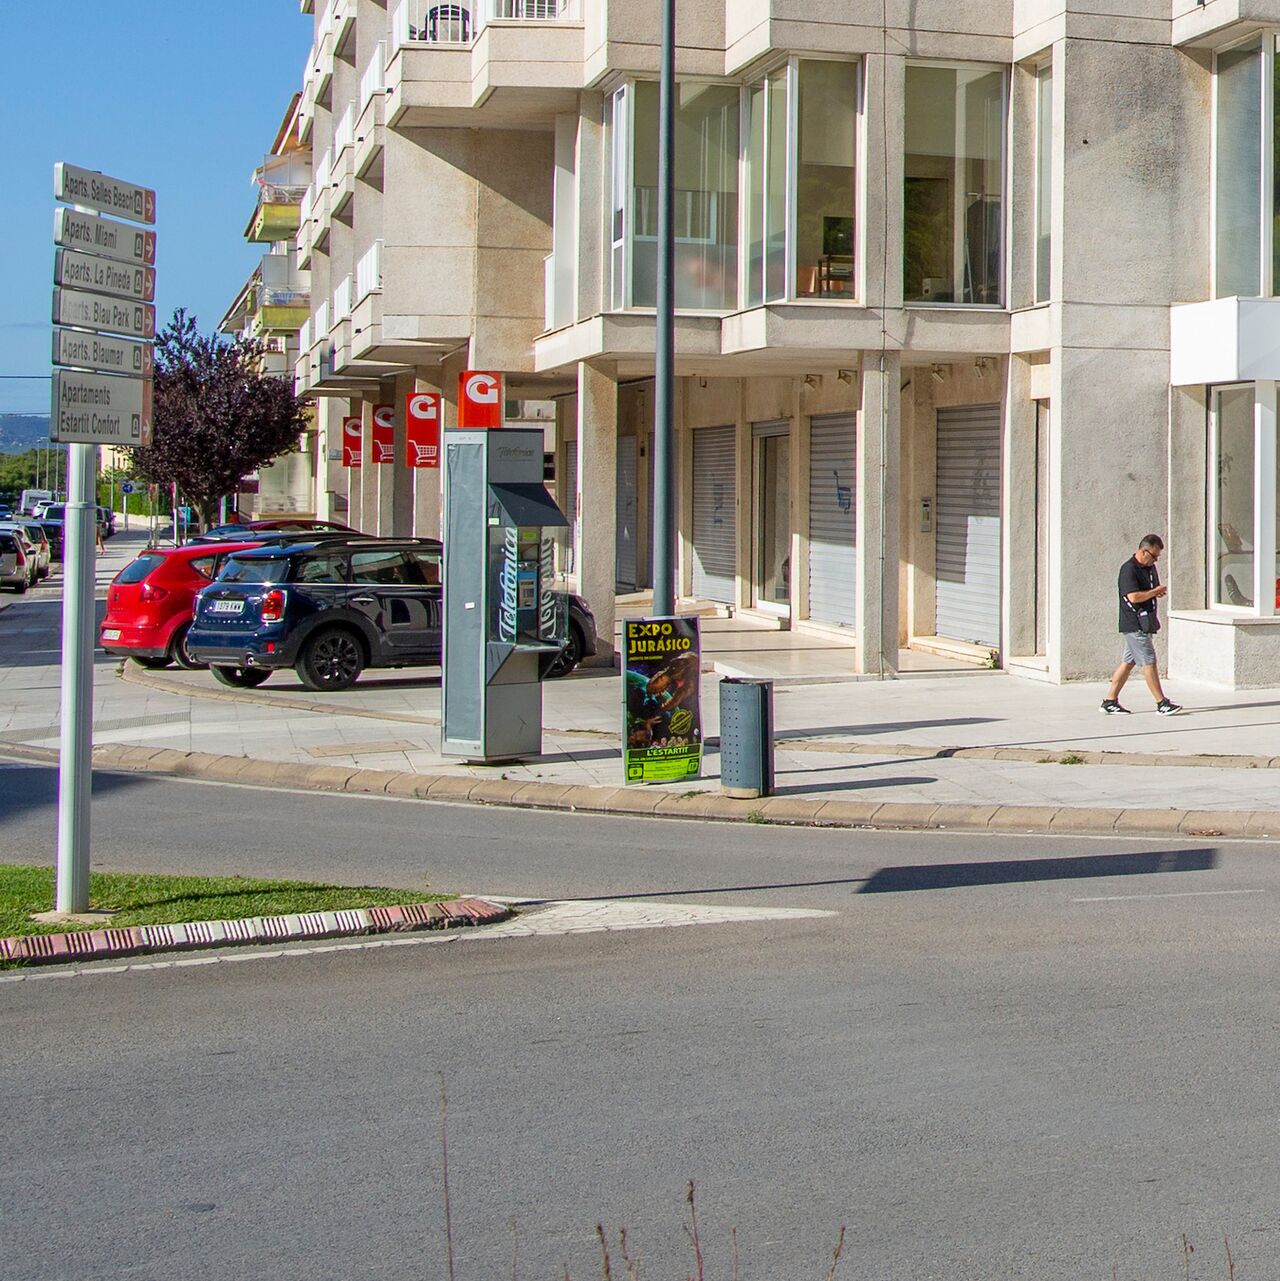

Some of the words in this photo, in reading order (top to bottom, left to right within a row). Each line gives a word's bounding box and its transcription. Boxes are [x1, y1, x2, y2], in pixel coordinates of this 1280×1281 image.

[64, 171, 90, 199] Aparts.
[113, 186, 133, 211] Beach
[64, 215, 92, 243] Aparts.
[95, 223, 117, 249] Miami
[64, 257, 92, 283] Aparts.
[95, 263, 104, 285] La
[106, 266, 130, 290] Pineda
[93, 302, 110, 324] Blau
[113, 305, 130, 328] Park
[62, 336, 90, 362] Aparts.
[93, 341, 124, 366] Blaumar
[62, 381, 111, 408] Apartaments
[60, 411, 89, 434] Estartit
[92, 413, 121, 436] Confort
[628, 623, 673, 638] EXPO
[629, 635, 691, 654] JURÁSICO
[646, 746, 689, 757] L'ESTARTIT
